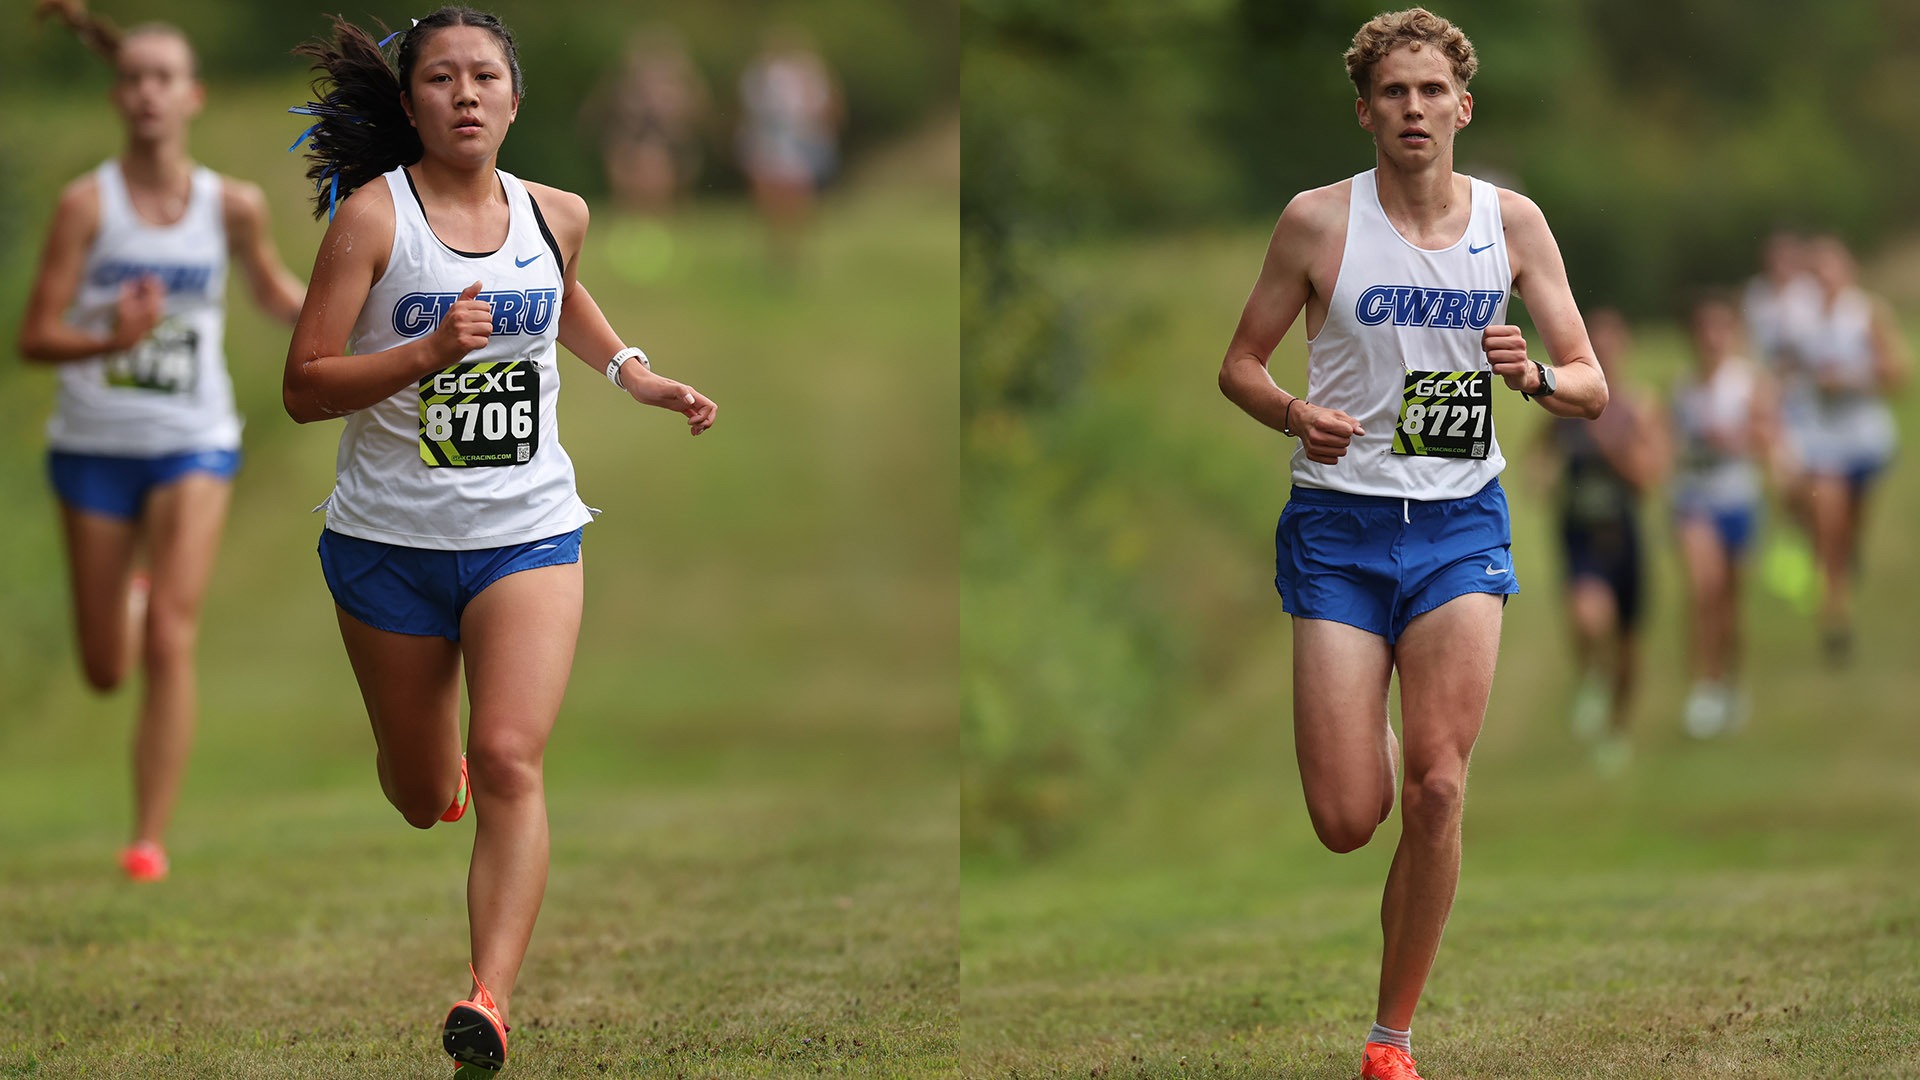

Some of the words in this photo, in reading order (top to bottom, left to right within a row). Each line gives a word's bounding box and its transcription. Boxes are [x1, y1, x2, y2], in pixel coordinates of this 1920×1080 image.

[1355, 284, 1504, 330] CWRU
[433, 370, 526, 394] GCXC
[1415, 379, 1483, 398] GCXC
[425, 400, 533, 442] 8706
[1402, 403, 1487, 438] 8727
